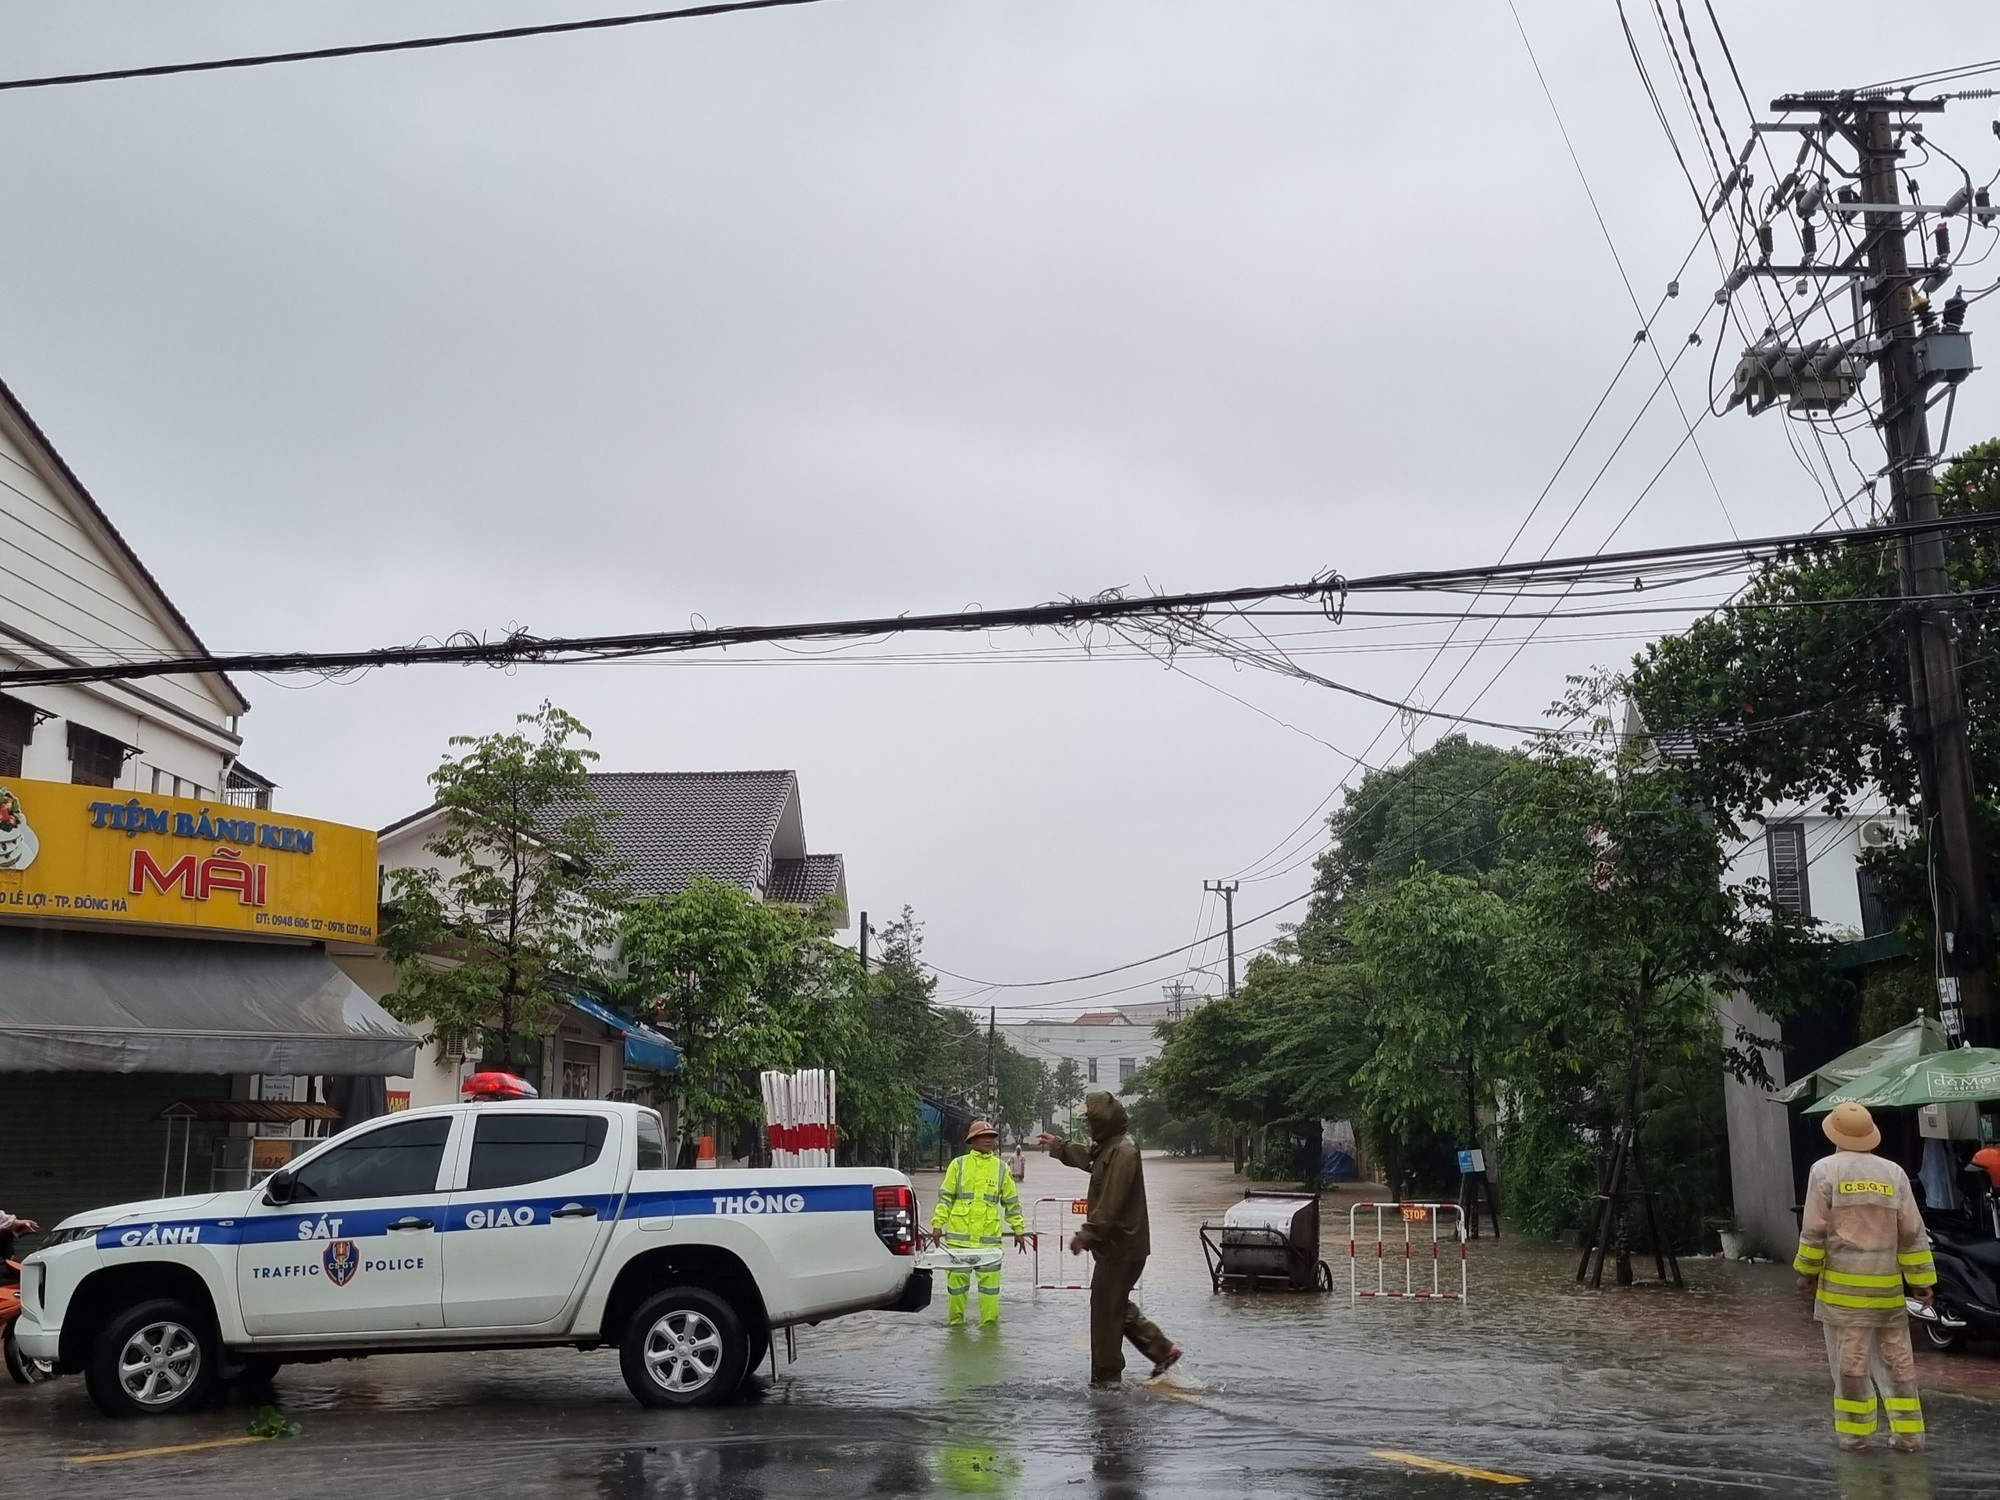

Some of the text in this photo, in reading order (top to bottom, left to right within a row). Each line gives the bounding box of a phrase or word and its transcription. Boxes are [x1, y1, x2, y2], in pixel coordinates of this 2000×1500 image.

[88, 798, 315, 854] TIỆM BÁNH KEM
[129, 846, 267, 906] MÃI
[10, 890, 24, 905] LÊ
[27, 893, 46, 909] LỢI
[55, 895, 71, 908] TP.
[74, 895, 109, 910] ĐÔNG
[111, 897, 128, 912] HÀ
[256, 913, 270, 925] ĐT:
[272, 914, 293, 927] 0948
[294, 917, 309, 929] 606
[311, 919, 323, 930] 127
[328, 920, 345, 933] 0976
[346, 923, 358, 935] 037
[359, 925, 372, 937] 664
[1844, 1183, 1889, 1193] C.S.G.T
[120, 1190, 806, 1248] CẢNH SÁT GIAO THÔNG
[1072, 1203, 1089, 1213] STO
[1403, 1209, 1426, 1219] STOP
[252, 1257, 425, 1280] TRAFFIC POLICE
[328, 1261, 354, 1270] CSGT
